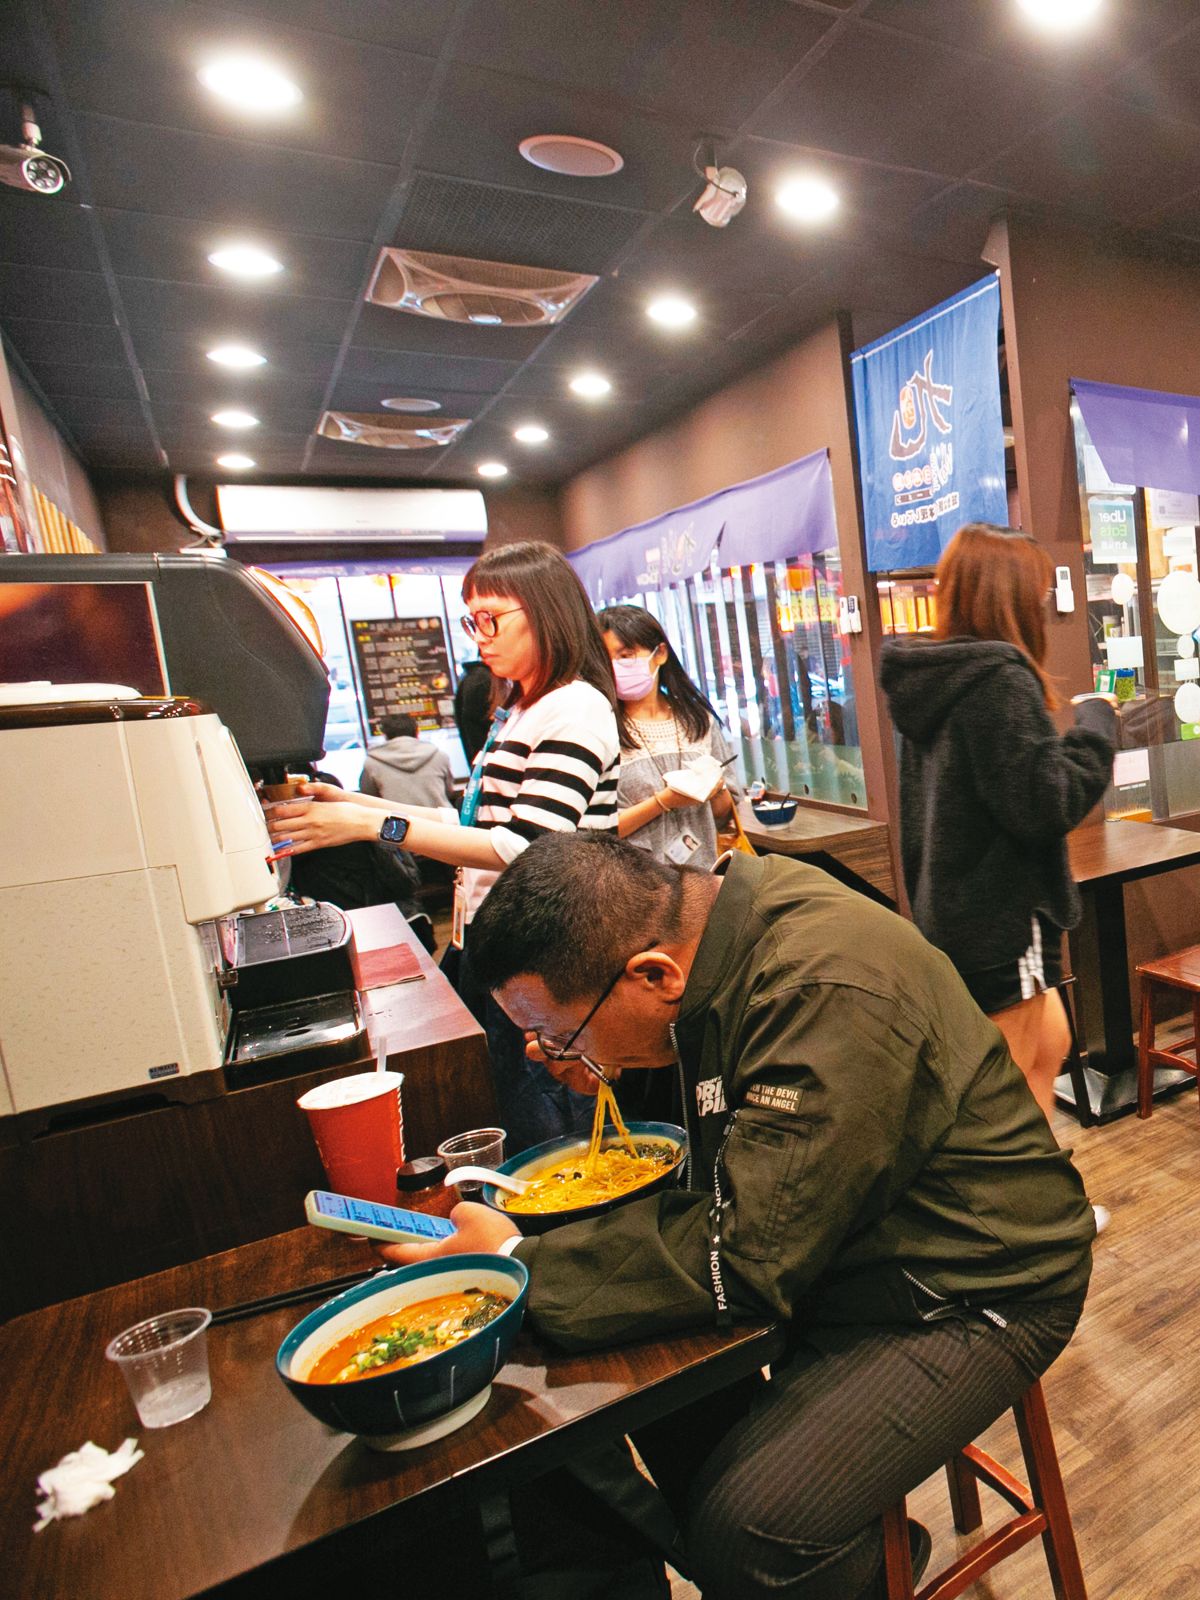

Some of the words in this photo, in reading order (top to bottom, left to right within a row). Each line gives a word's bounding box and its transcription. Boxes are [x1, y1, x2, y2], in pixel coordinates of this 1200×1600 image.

[761, 1085, 775, 1095] THE
[776, 1087, 799, 1101] DEVIL
[760, 1095, 771, 1106] AN
[771, 1097, 796, 1111] ANGEL
[711, 1250, 727, 1311] FASHION
